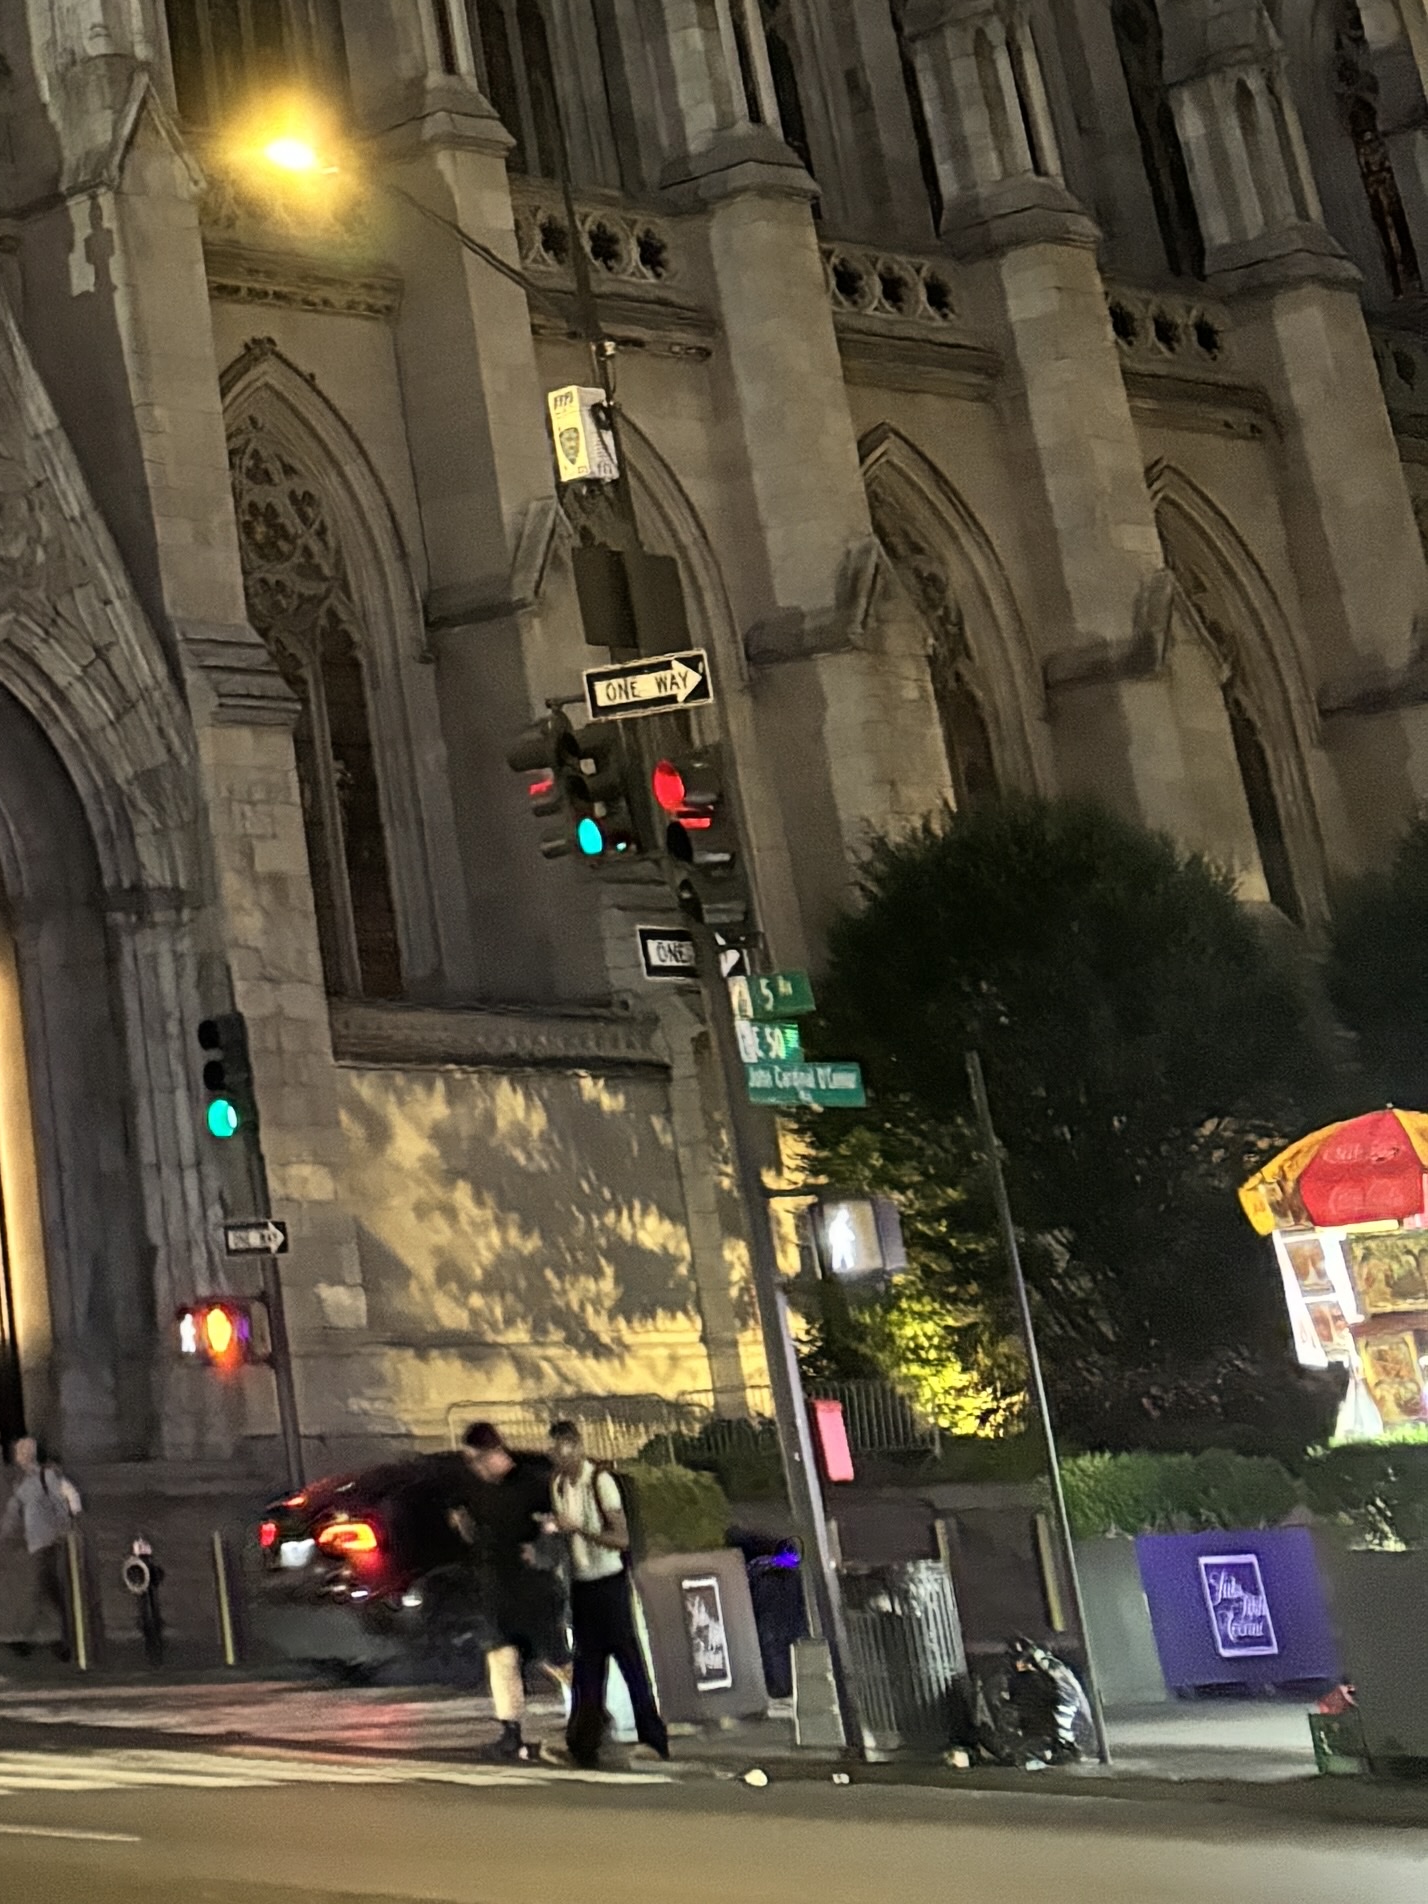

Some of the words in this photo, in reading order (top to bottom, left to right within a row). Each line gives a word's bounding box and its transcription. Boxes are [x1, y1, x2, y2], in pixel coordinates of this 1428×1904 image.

[605, 676, 641, 702] ONE
[654, 670, 689, 693] WAY
[656, 942, 688, 963] ONE
[760, 977, 774, 1011] 5
